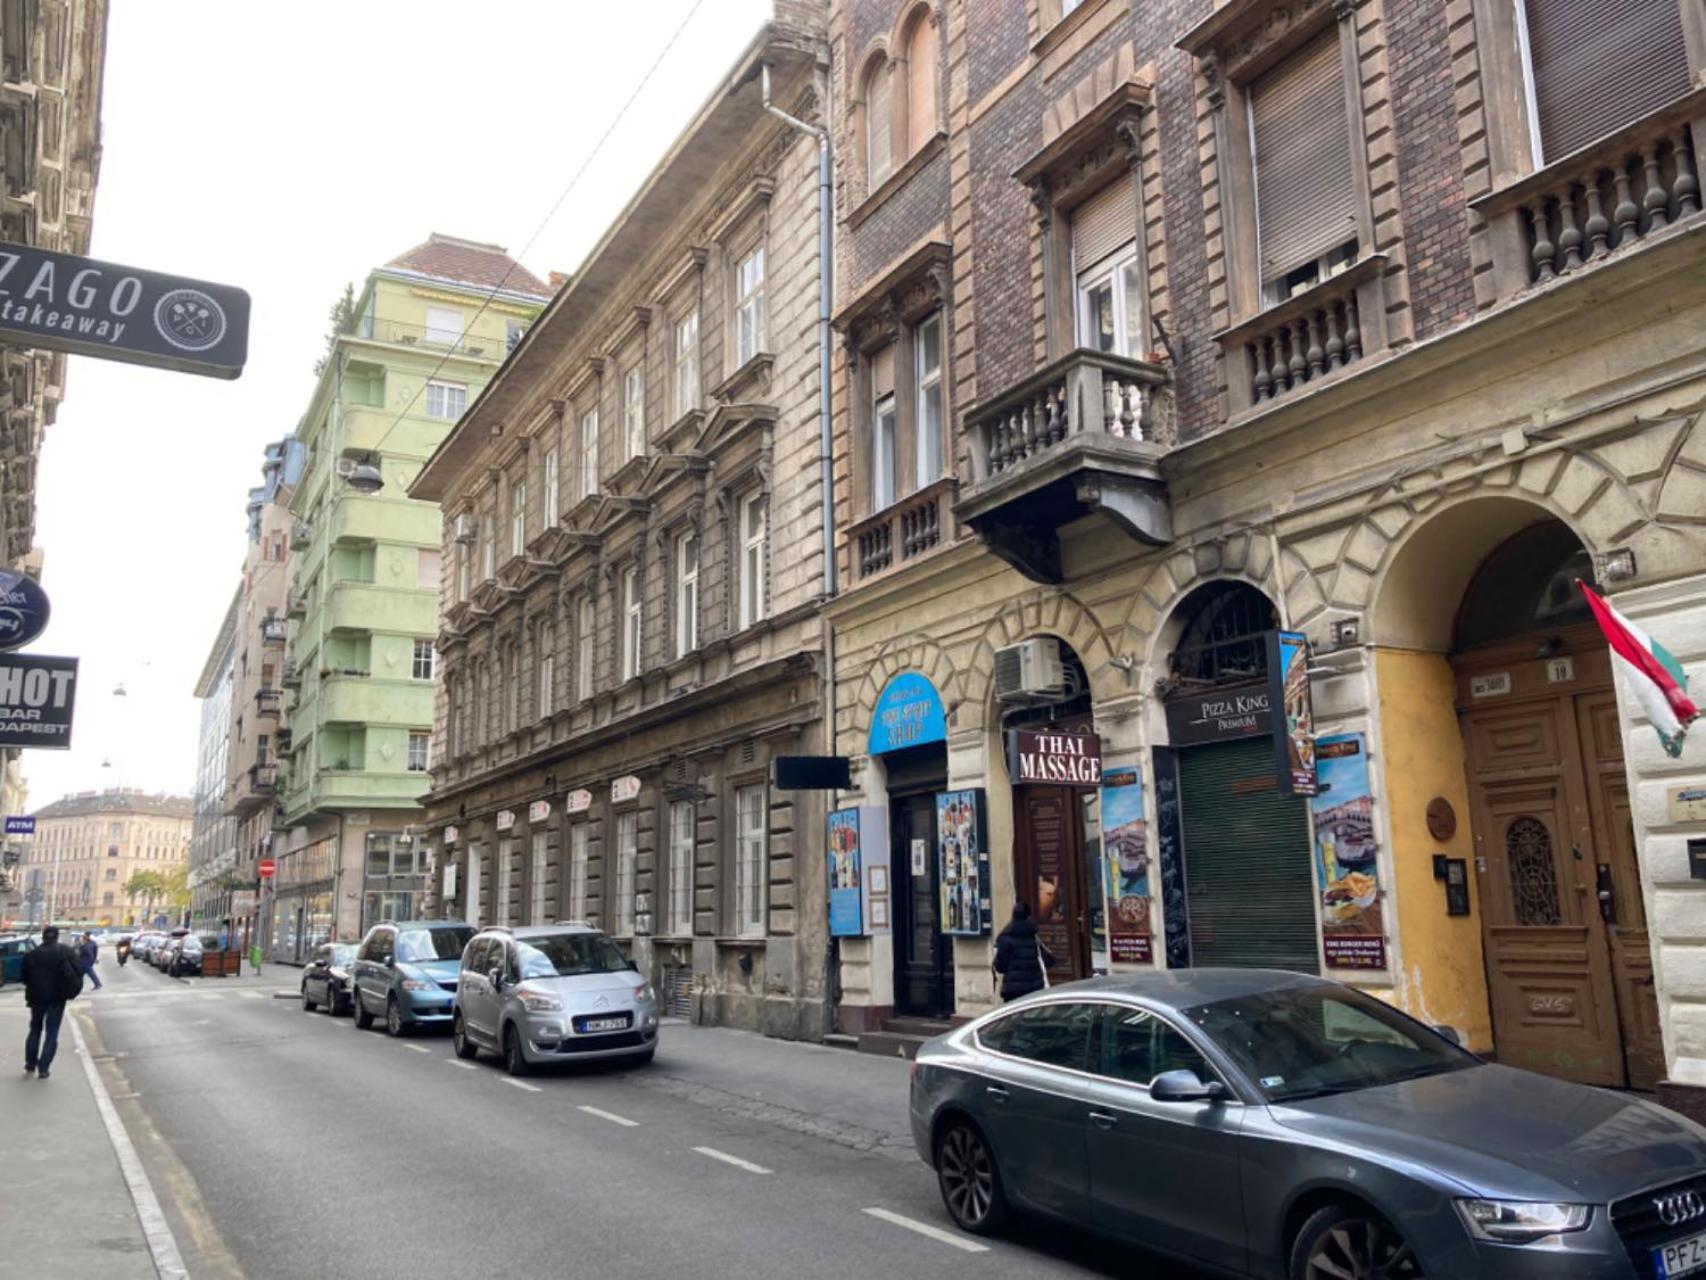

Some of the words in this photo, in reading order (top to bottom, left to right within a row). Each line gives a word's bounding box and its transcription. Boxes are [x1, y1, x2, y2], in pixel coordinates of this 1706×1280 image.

[2, 300, 126, 342] takeaway
[0, 667, 74, 708] HOT
[0, 709, 41, 720] BAR
[1201, 702, 1234, 718] PIZZA
[1235, 694, 1269, 713] KING
[1035, 735, 1084, 755] THAI
[1020, 752, 1100, 783] MASSAGE
[8, 821, 33, 829] ATM
